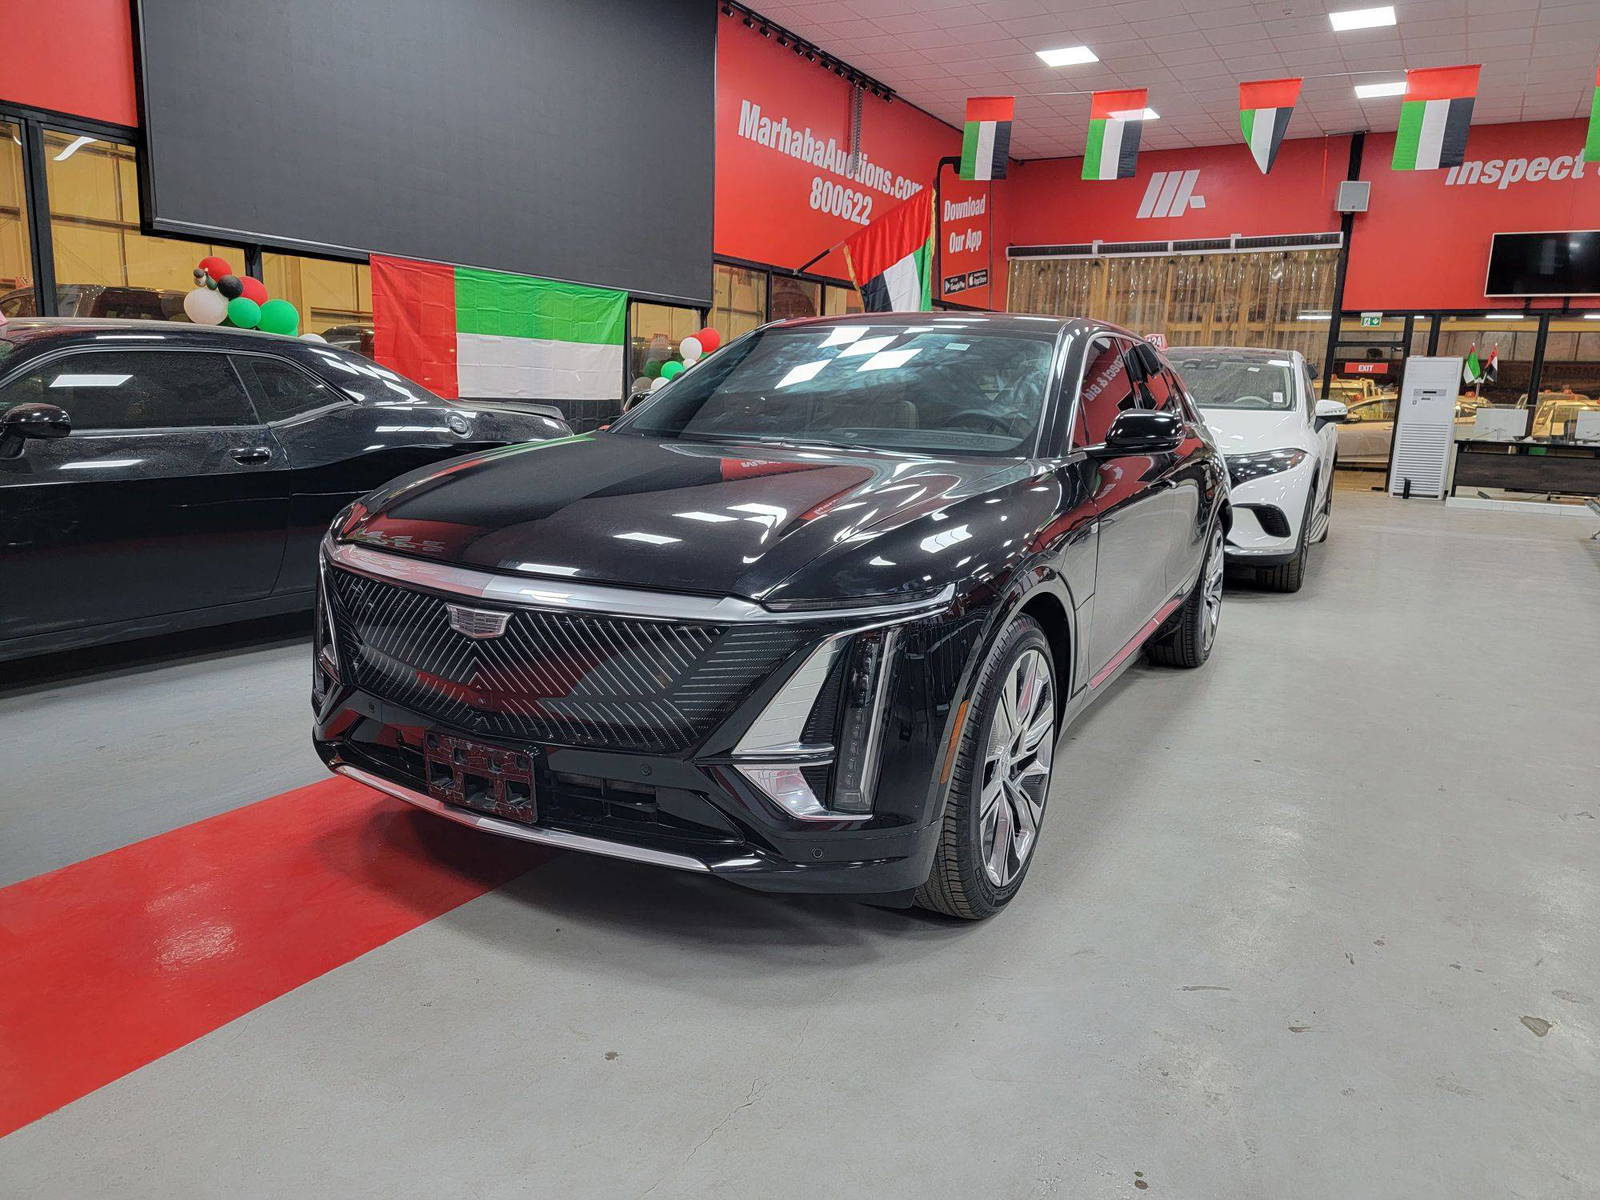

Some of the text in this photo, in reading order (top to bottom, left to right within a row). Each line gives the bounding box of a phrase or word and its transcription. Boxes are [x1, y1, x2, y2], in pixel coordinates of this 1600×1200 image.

[810, 177, 873, 226] 800622
[944, 193, 986, 222] Download
[949, 228, 982, 254] Our App
[1358, 364, 1374, 372] EXIT
